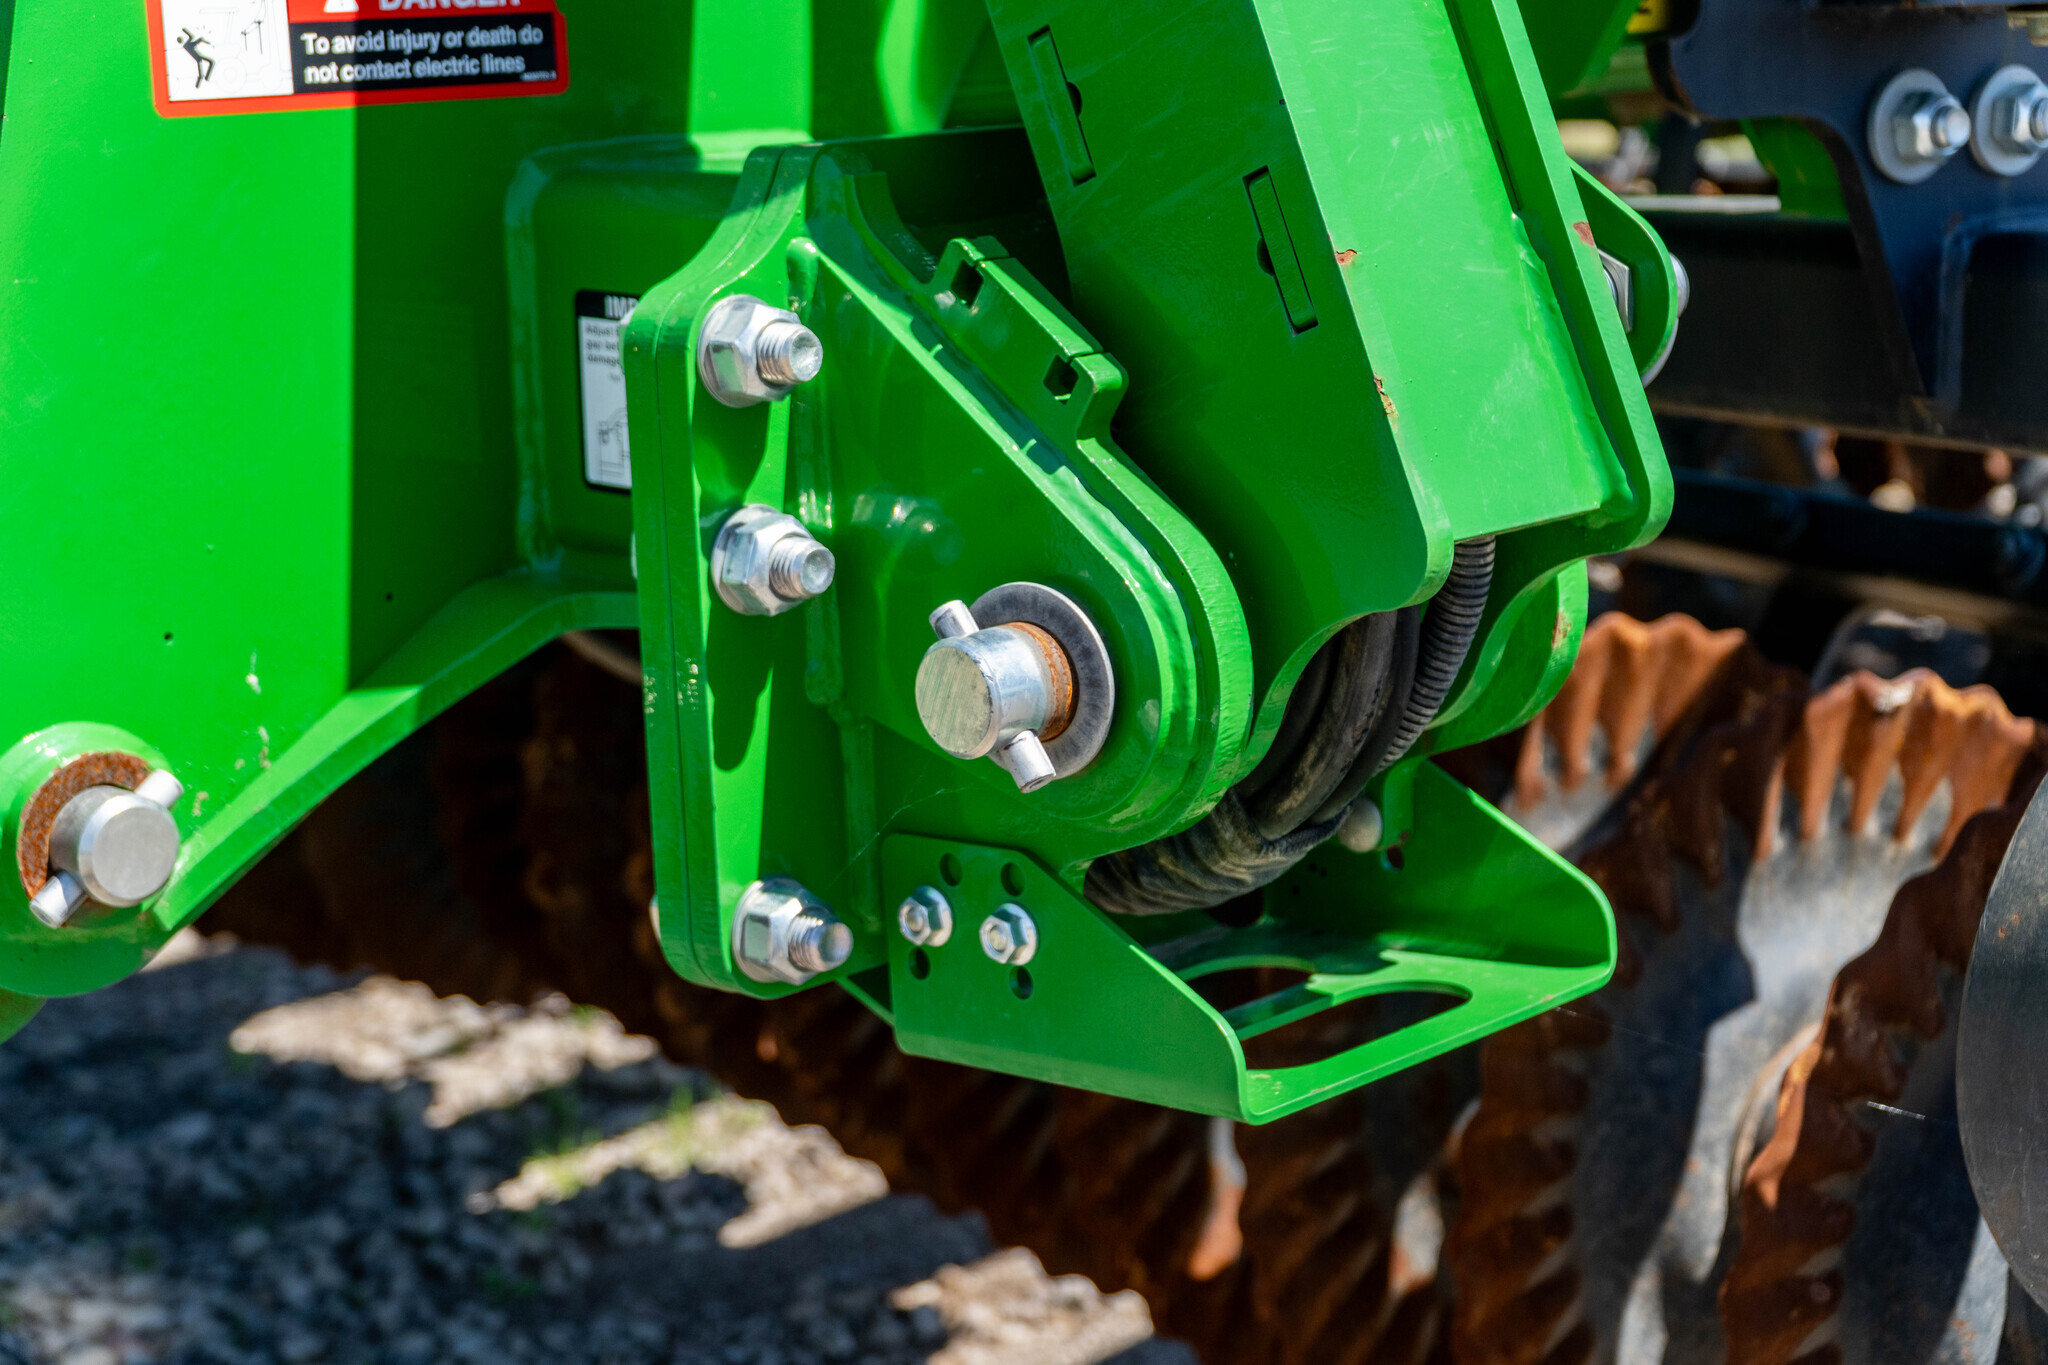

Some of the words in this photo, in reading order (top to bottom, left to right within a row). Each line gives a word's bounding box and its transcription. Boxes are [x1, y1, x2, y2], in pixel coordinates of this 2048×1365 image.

[300, 32, 330, 55] To
[331, 30, 385, 54] avoid
[386, 28, 440, 55] injury
[442, 30, 465, 49] or
[465, 24, 517, 47] death
[517, 23, 544, 45] do
[304, 61, 339, 84] not
[340, 58, 412, 83] contact
[412, 55, 480, 79] electric
[481, 52, 526, 74] lines
